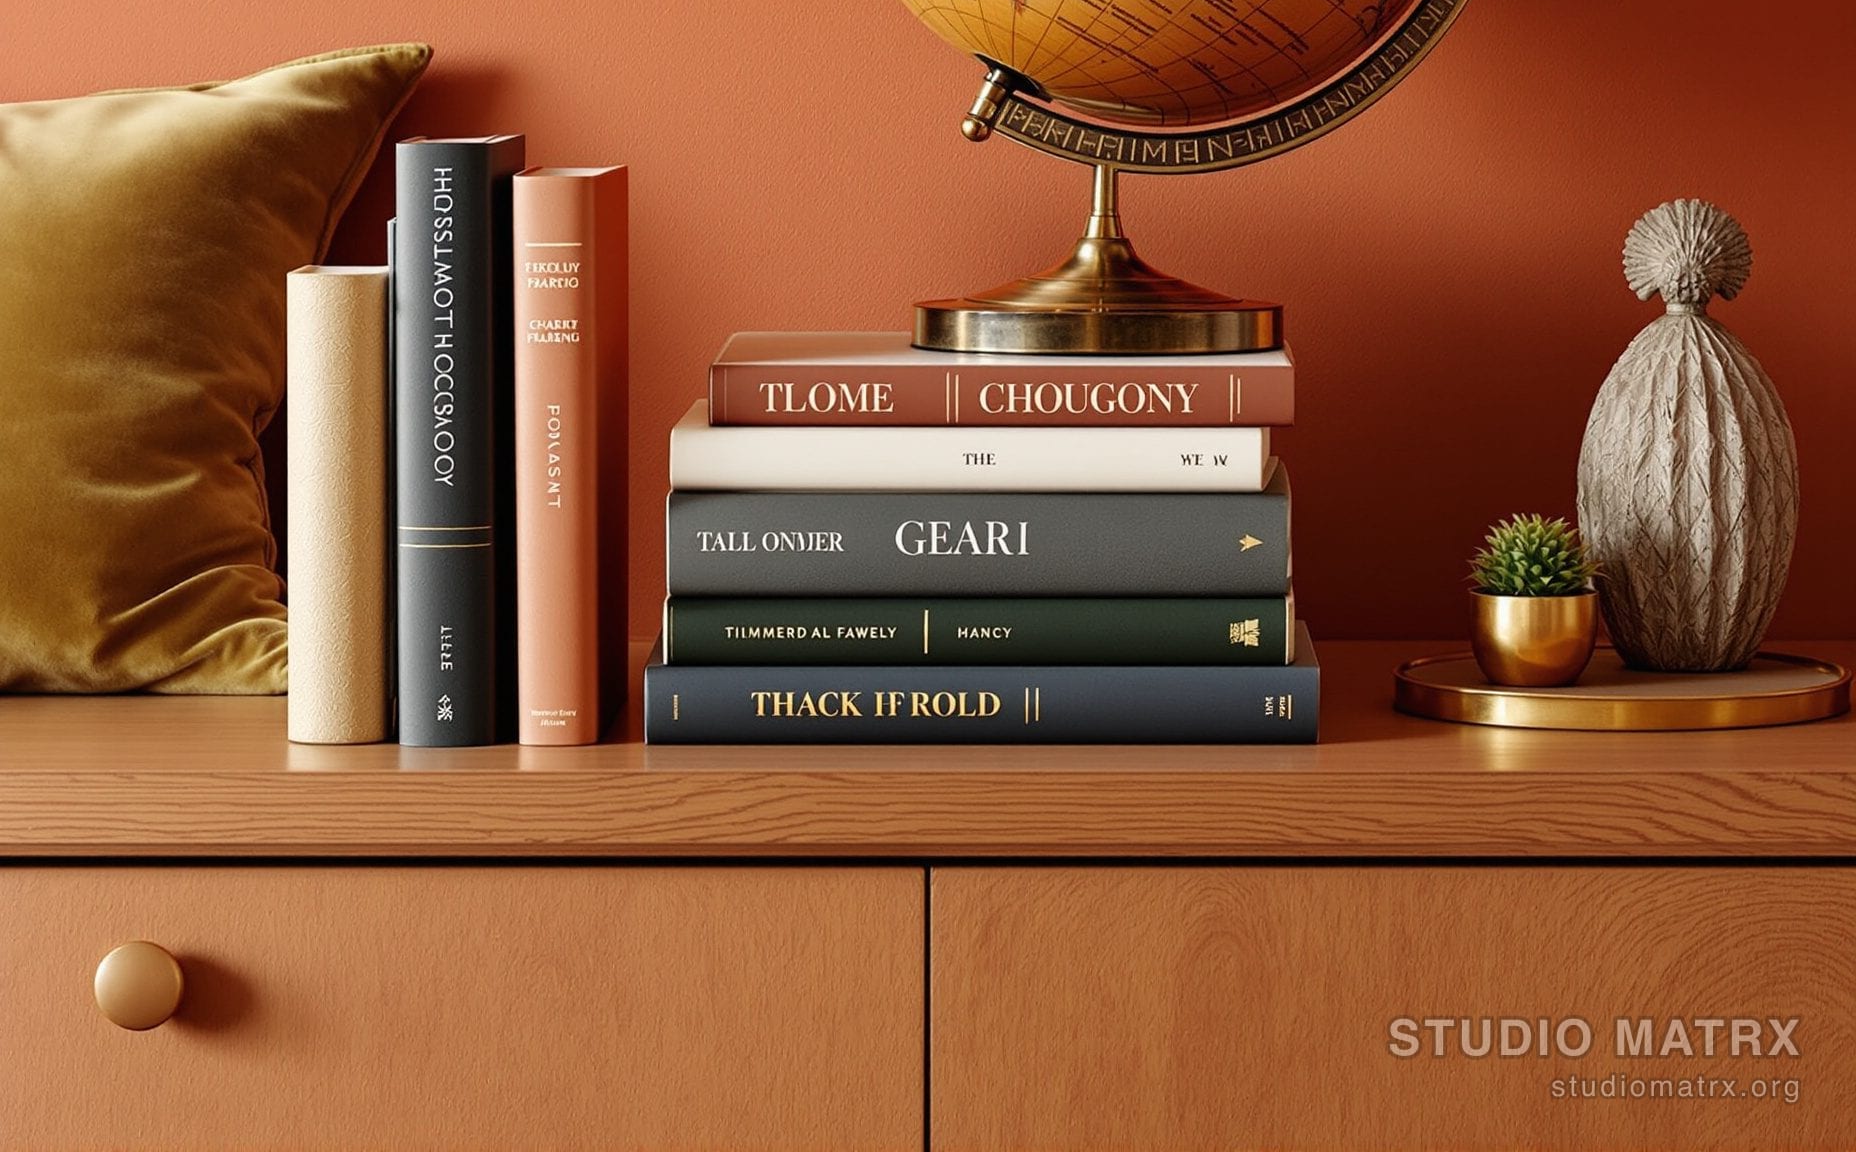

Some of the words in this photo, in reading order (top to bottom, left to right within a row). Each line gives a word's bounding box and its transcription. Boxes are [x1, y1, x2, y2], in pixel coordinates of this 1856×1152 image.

[760, 382, 895, 413] TLOME
[978, 382, 1199, 414] CHOUGONY
[962, 453, 997, 466] THE
[697, 531, 757, 552] TALL
[837, 626, 898, 639] FAWELY
[957, 626, 1013, 639] HANCY
[750, 691, 863, 717] THACK
[911, 691, 1001, 717] ROLD
